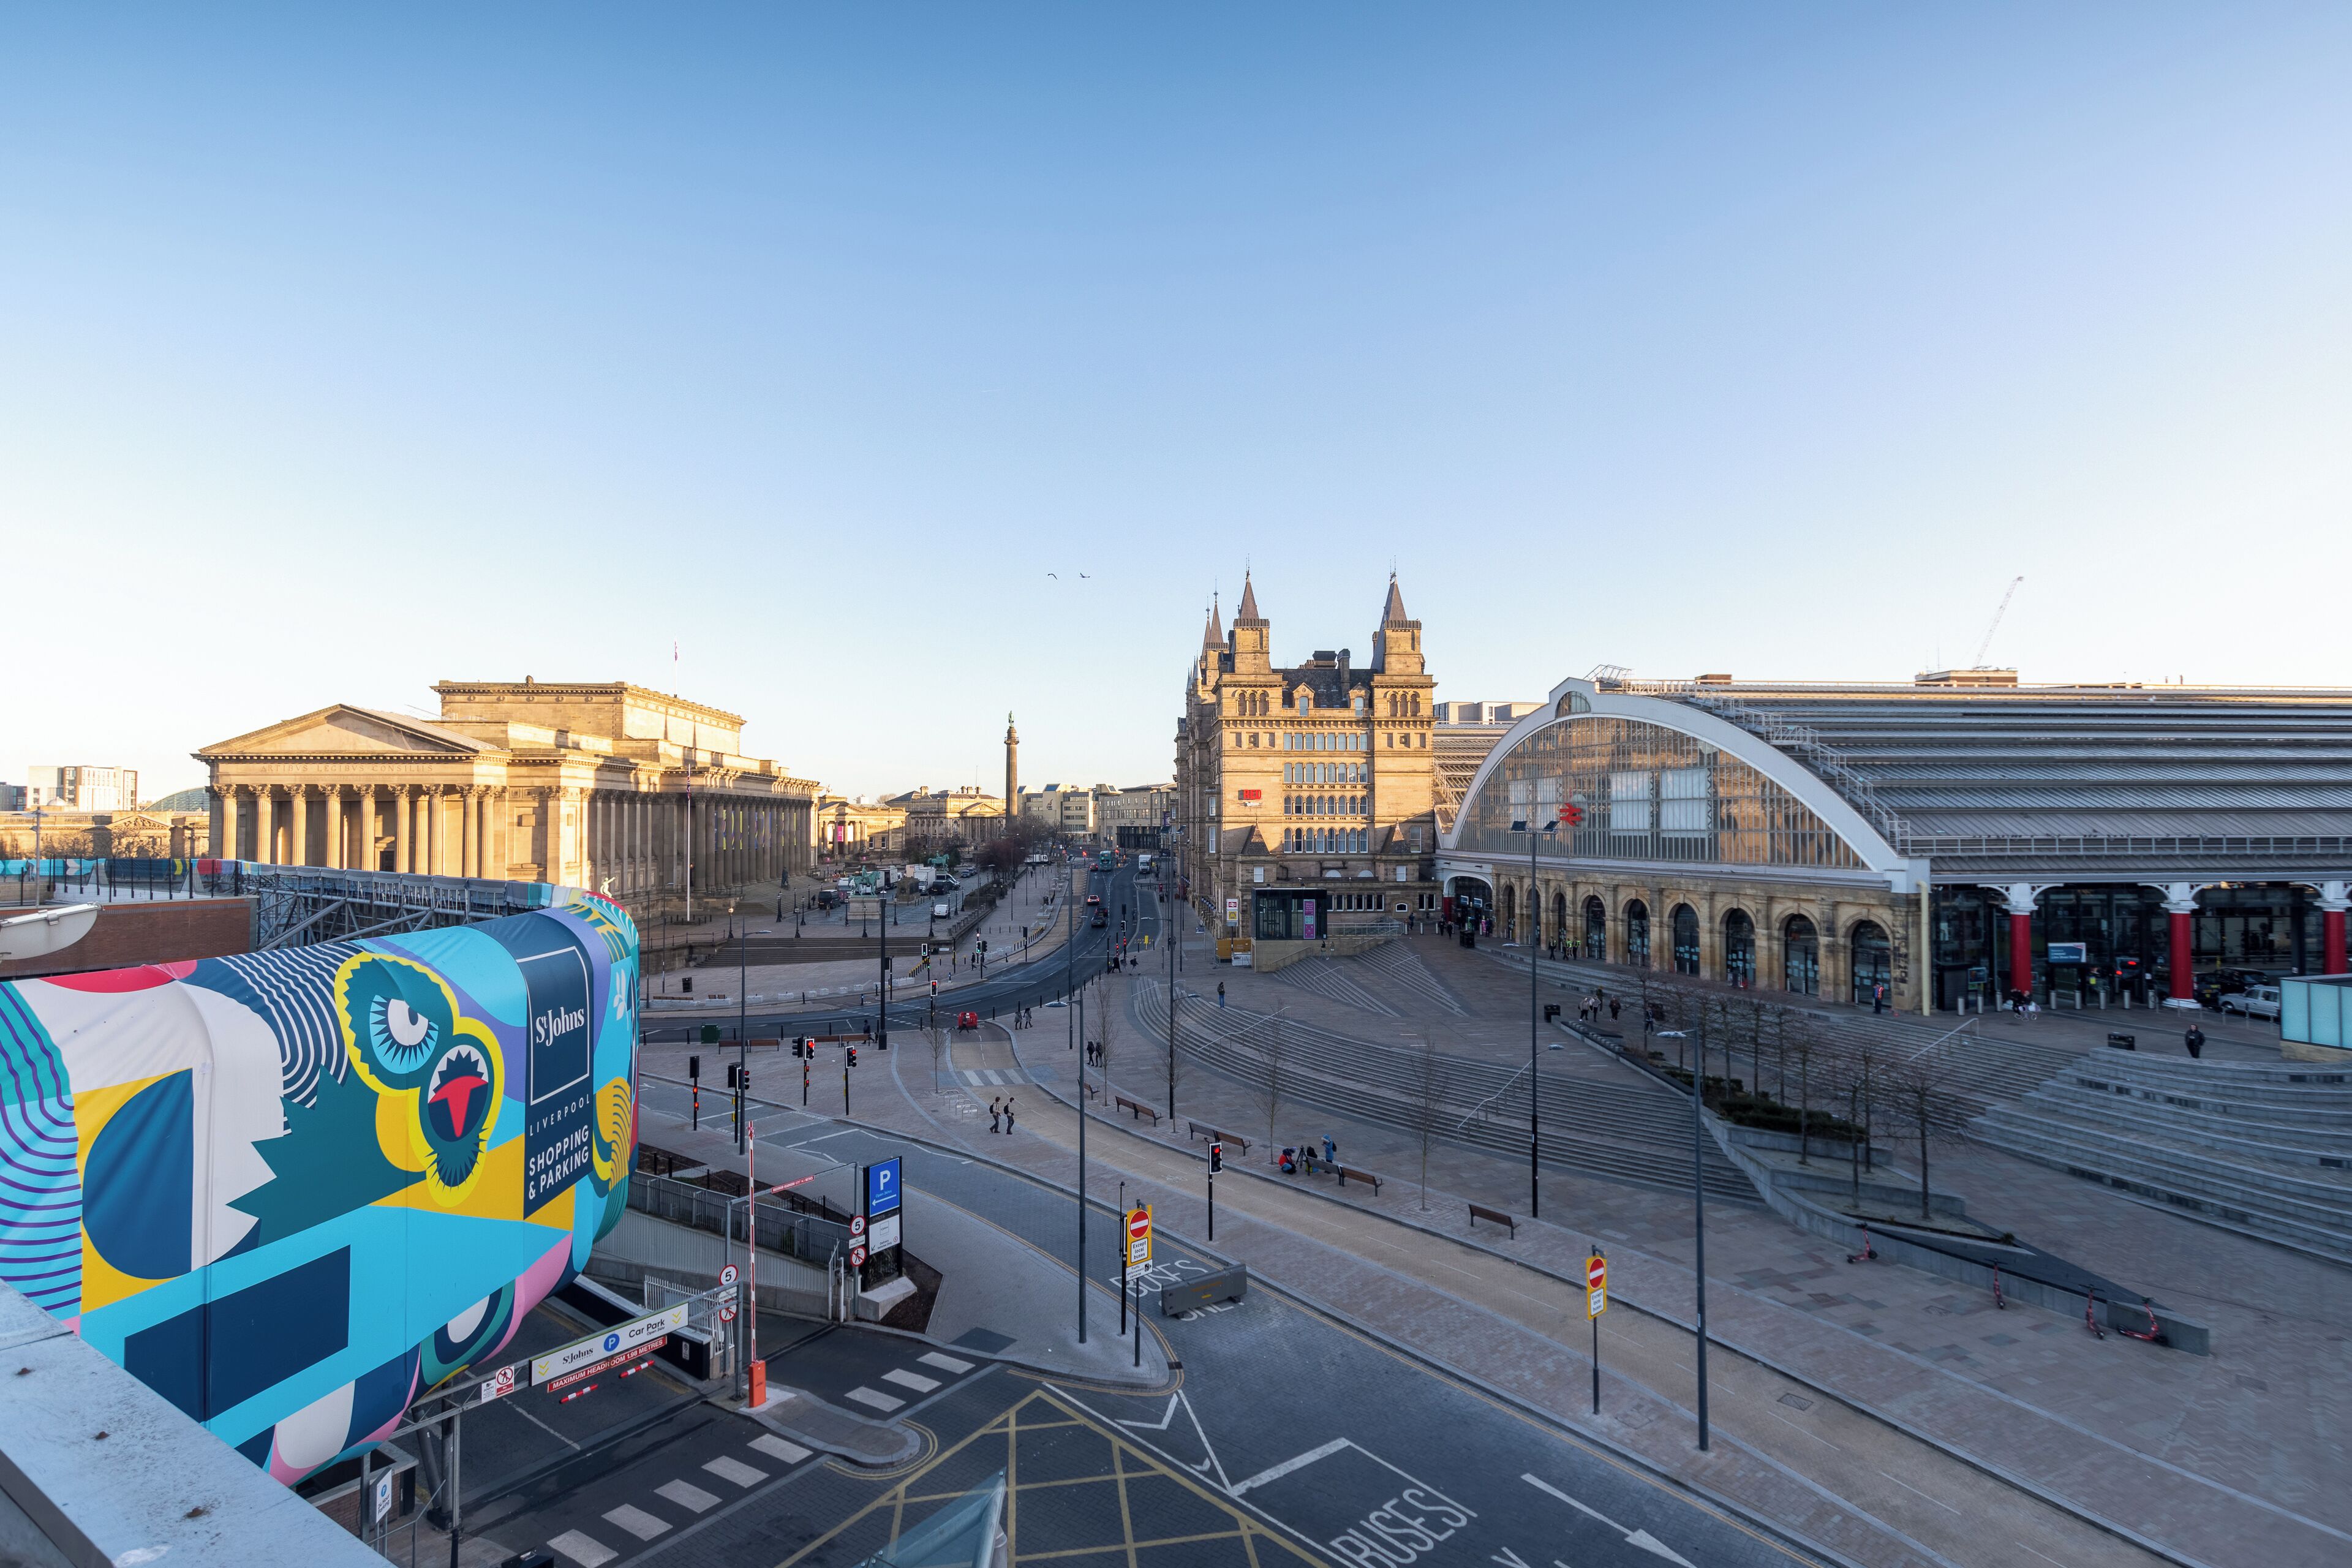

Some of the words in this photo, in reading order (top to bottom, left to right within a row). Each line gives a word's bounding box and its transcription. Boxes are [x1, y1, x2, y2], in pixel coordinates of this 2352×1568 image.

[1244, 790, 1261, 799] RED
[530, 1094, 589, 1136] LIVERPOOL
[529, 1125, 589, 1176] SHOPPING
[529, 1181, 536, 1200] &
[540, 1145, 589, 1193] PARKING
[880, 1170, 891, 1191] P
[854, 1220, 861, 1231] 5
[1133, 1240, 1147, 1249] Except
[725, 1270, 732, 1282] 5
[628, 1327, 644, 1338] Car
[647, 1318, 665, 1332] Park
[608, 1337, 616, 1349] P
[552, 1371, 586, 1389] MAXIMUM
[627, 1351, 638, 1360] 1.98
[638, 1339, 663, 1355] METRES
